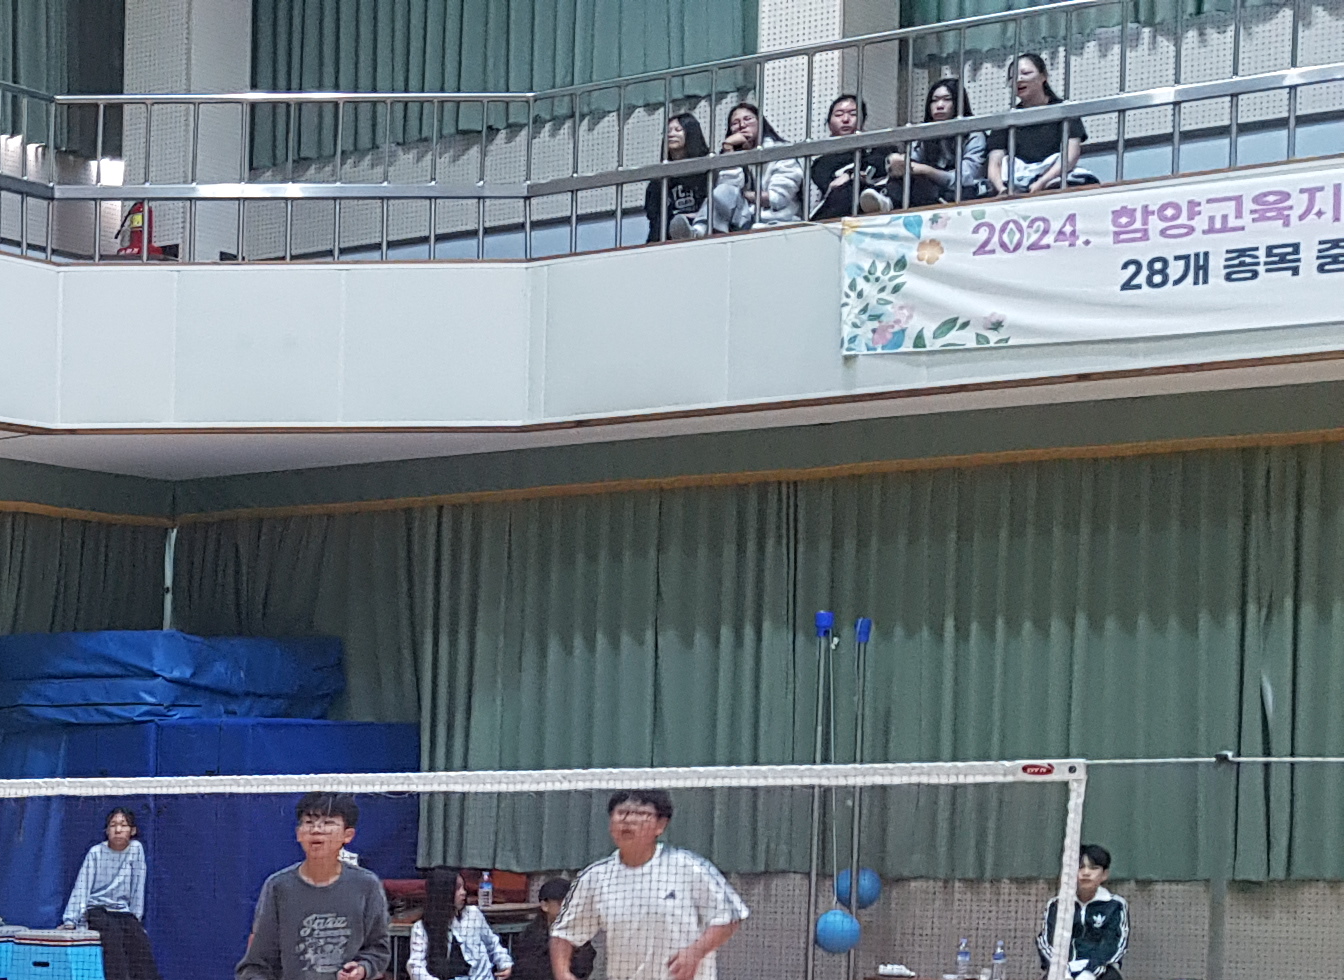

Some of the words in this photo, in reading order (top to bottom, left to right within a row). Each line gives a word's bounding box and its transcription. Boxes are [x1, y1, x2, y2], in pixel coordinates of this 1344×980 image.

[972, 212, 1092, 258] 2024.
[1119, 251, 1209, 291] 28개
[1222, 242, 1302, 282] 종목
